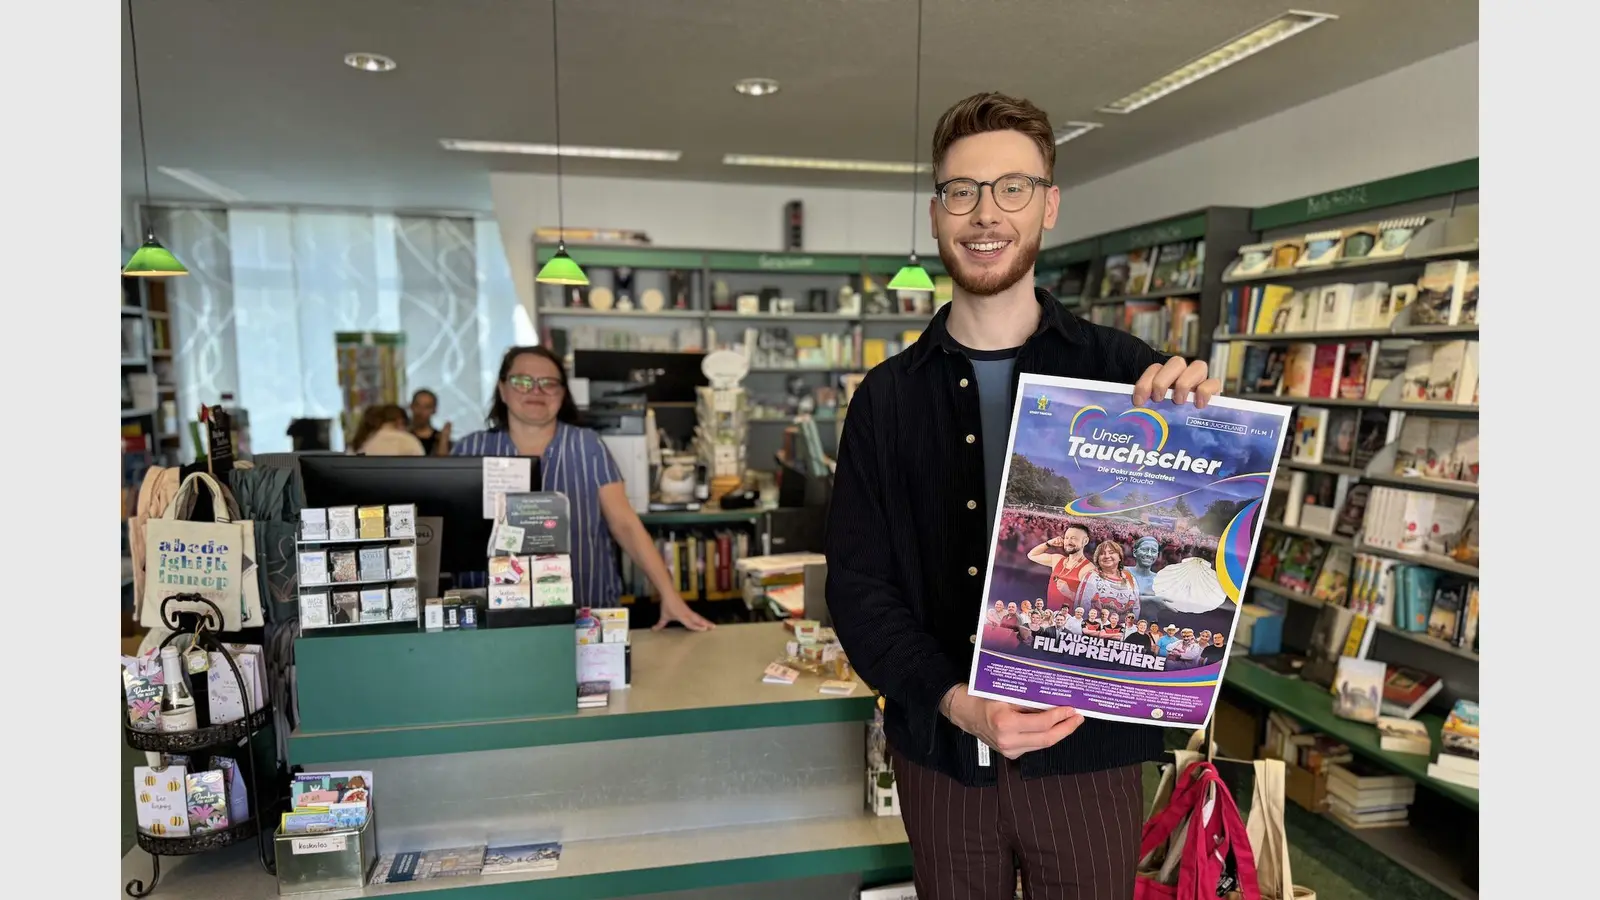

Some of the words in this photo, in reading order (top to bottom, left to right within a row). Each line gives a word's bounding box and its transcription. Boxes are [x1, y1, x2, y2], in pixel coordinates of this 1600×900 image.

[1092, 427, 1134, 444] Unser
[1190, 419, 1209, 427] JONAS
[1210, 422, 1244, 432] JUCKELAND
[1250, 428, 1268, 436] FILM
[1068, 436, 1223, 476] Tauchscher
[1097, 466, 1110, 474] Die
[1110, 467, 1129, 476] Doku
[1129, 470, 1143, 478] zum
[1144, 471, 1176, 482] Stadtfest
[1130, 476, 1154, 486] Taucha
[1060, 632, 1105, 648] TAUCHA
[1107, 640, 1145, 654] FEIERT
[1033, 636, 1166, 671] FILMPREMIERE
[133, 684, 156, 695] Danke
